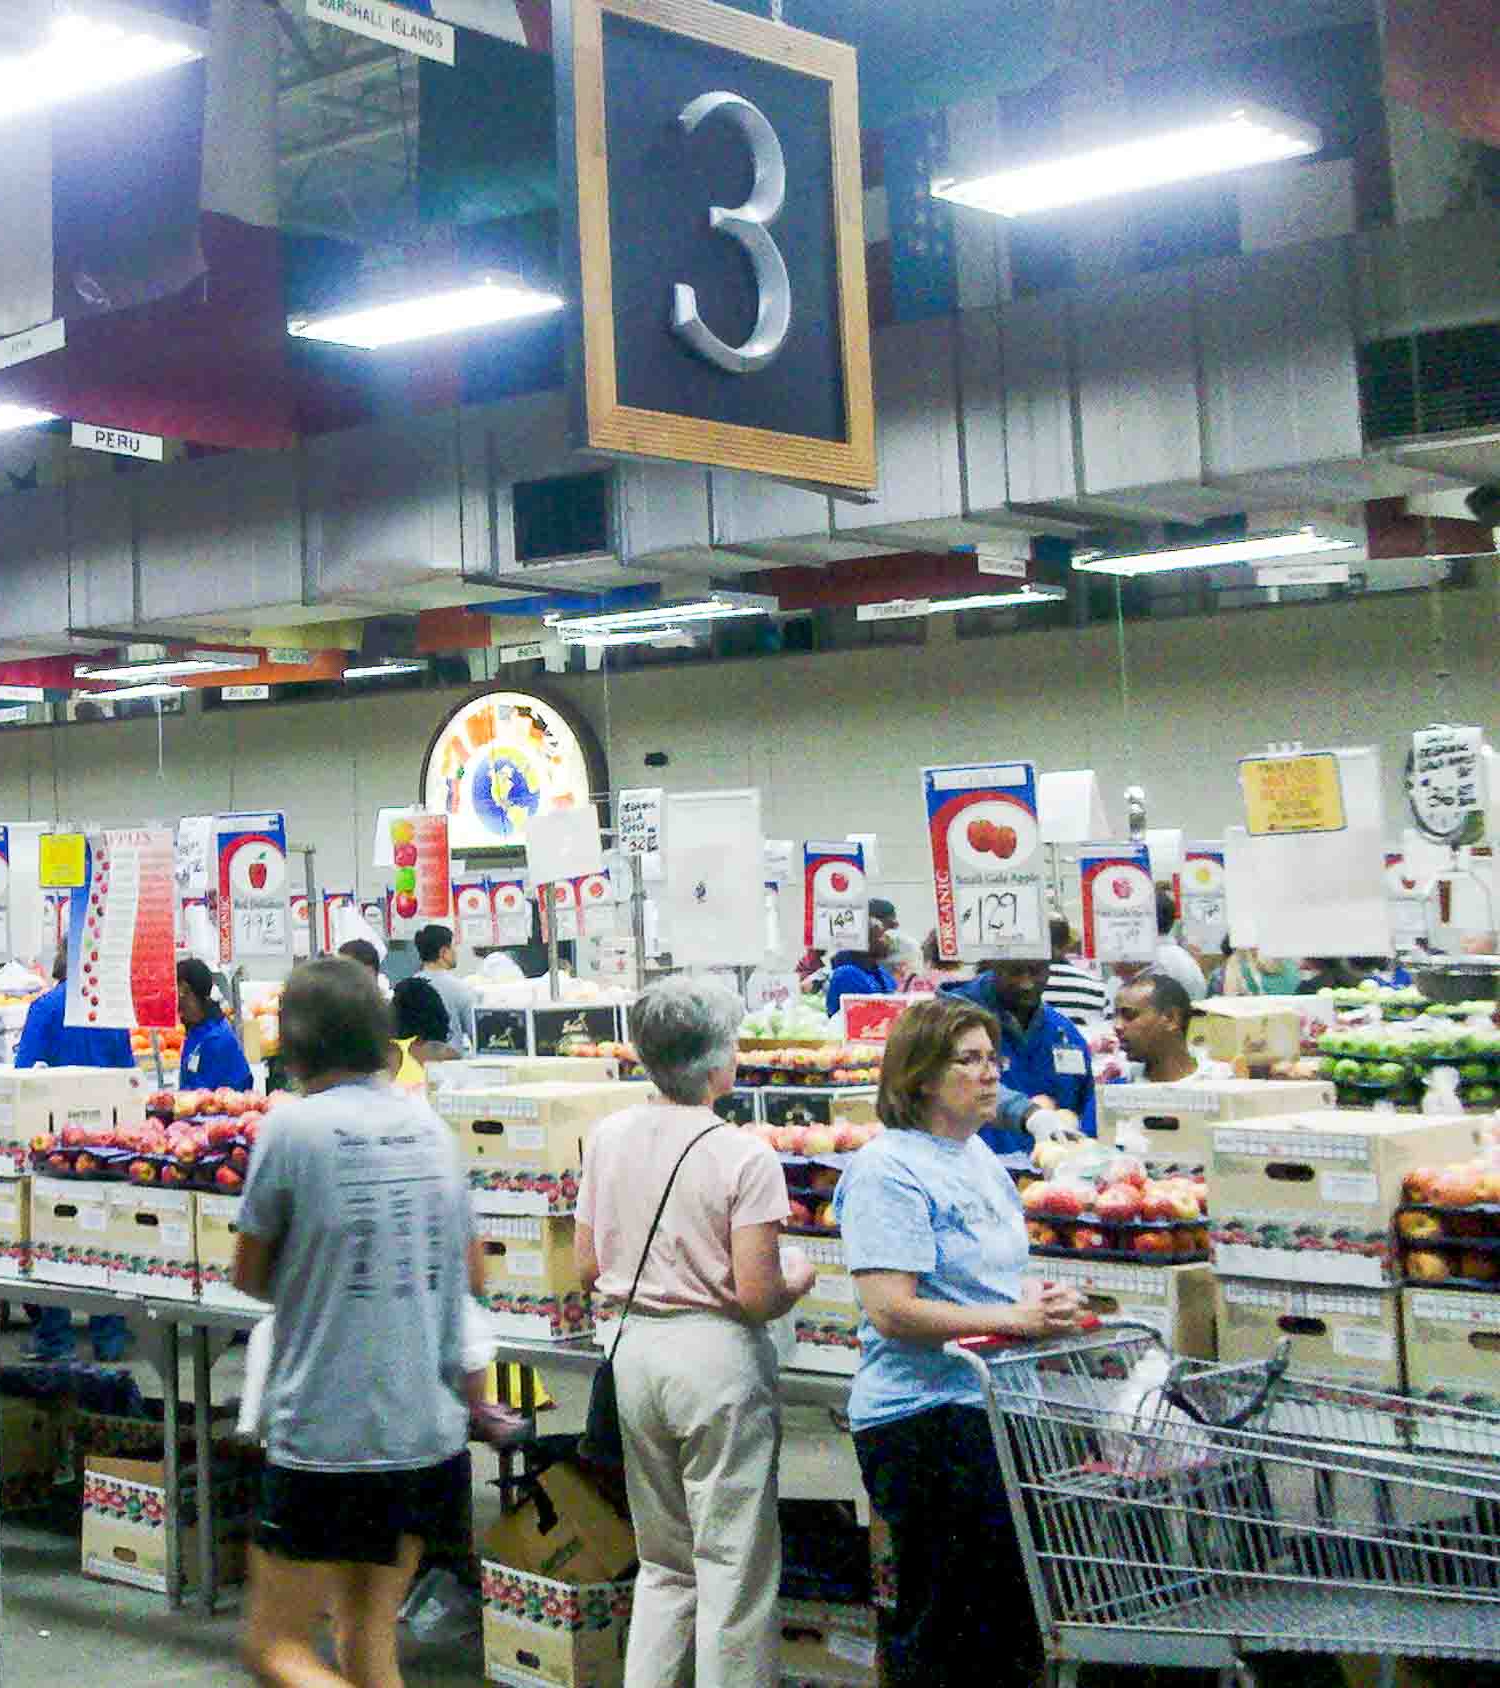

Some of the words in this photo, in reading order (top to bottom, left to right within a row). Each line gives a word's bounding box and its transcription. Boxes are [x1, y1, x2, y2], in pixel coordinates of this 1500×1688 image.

[391, 18, 443, 48] ISLANDS
[673, 90, 792, 373] 3
[95, 430, 140, 452] PERU
[936, 870, 957, 956] ORGANIC
